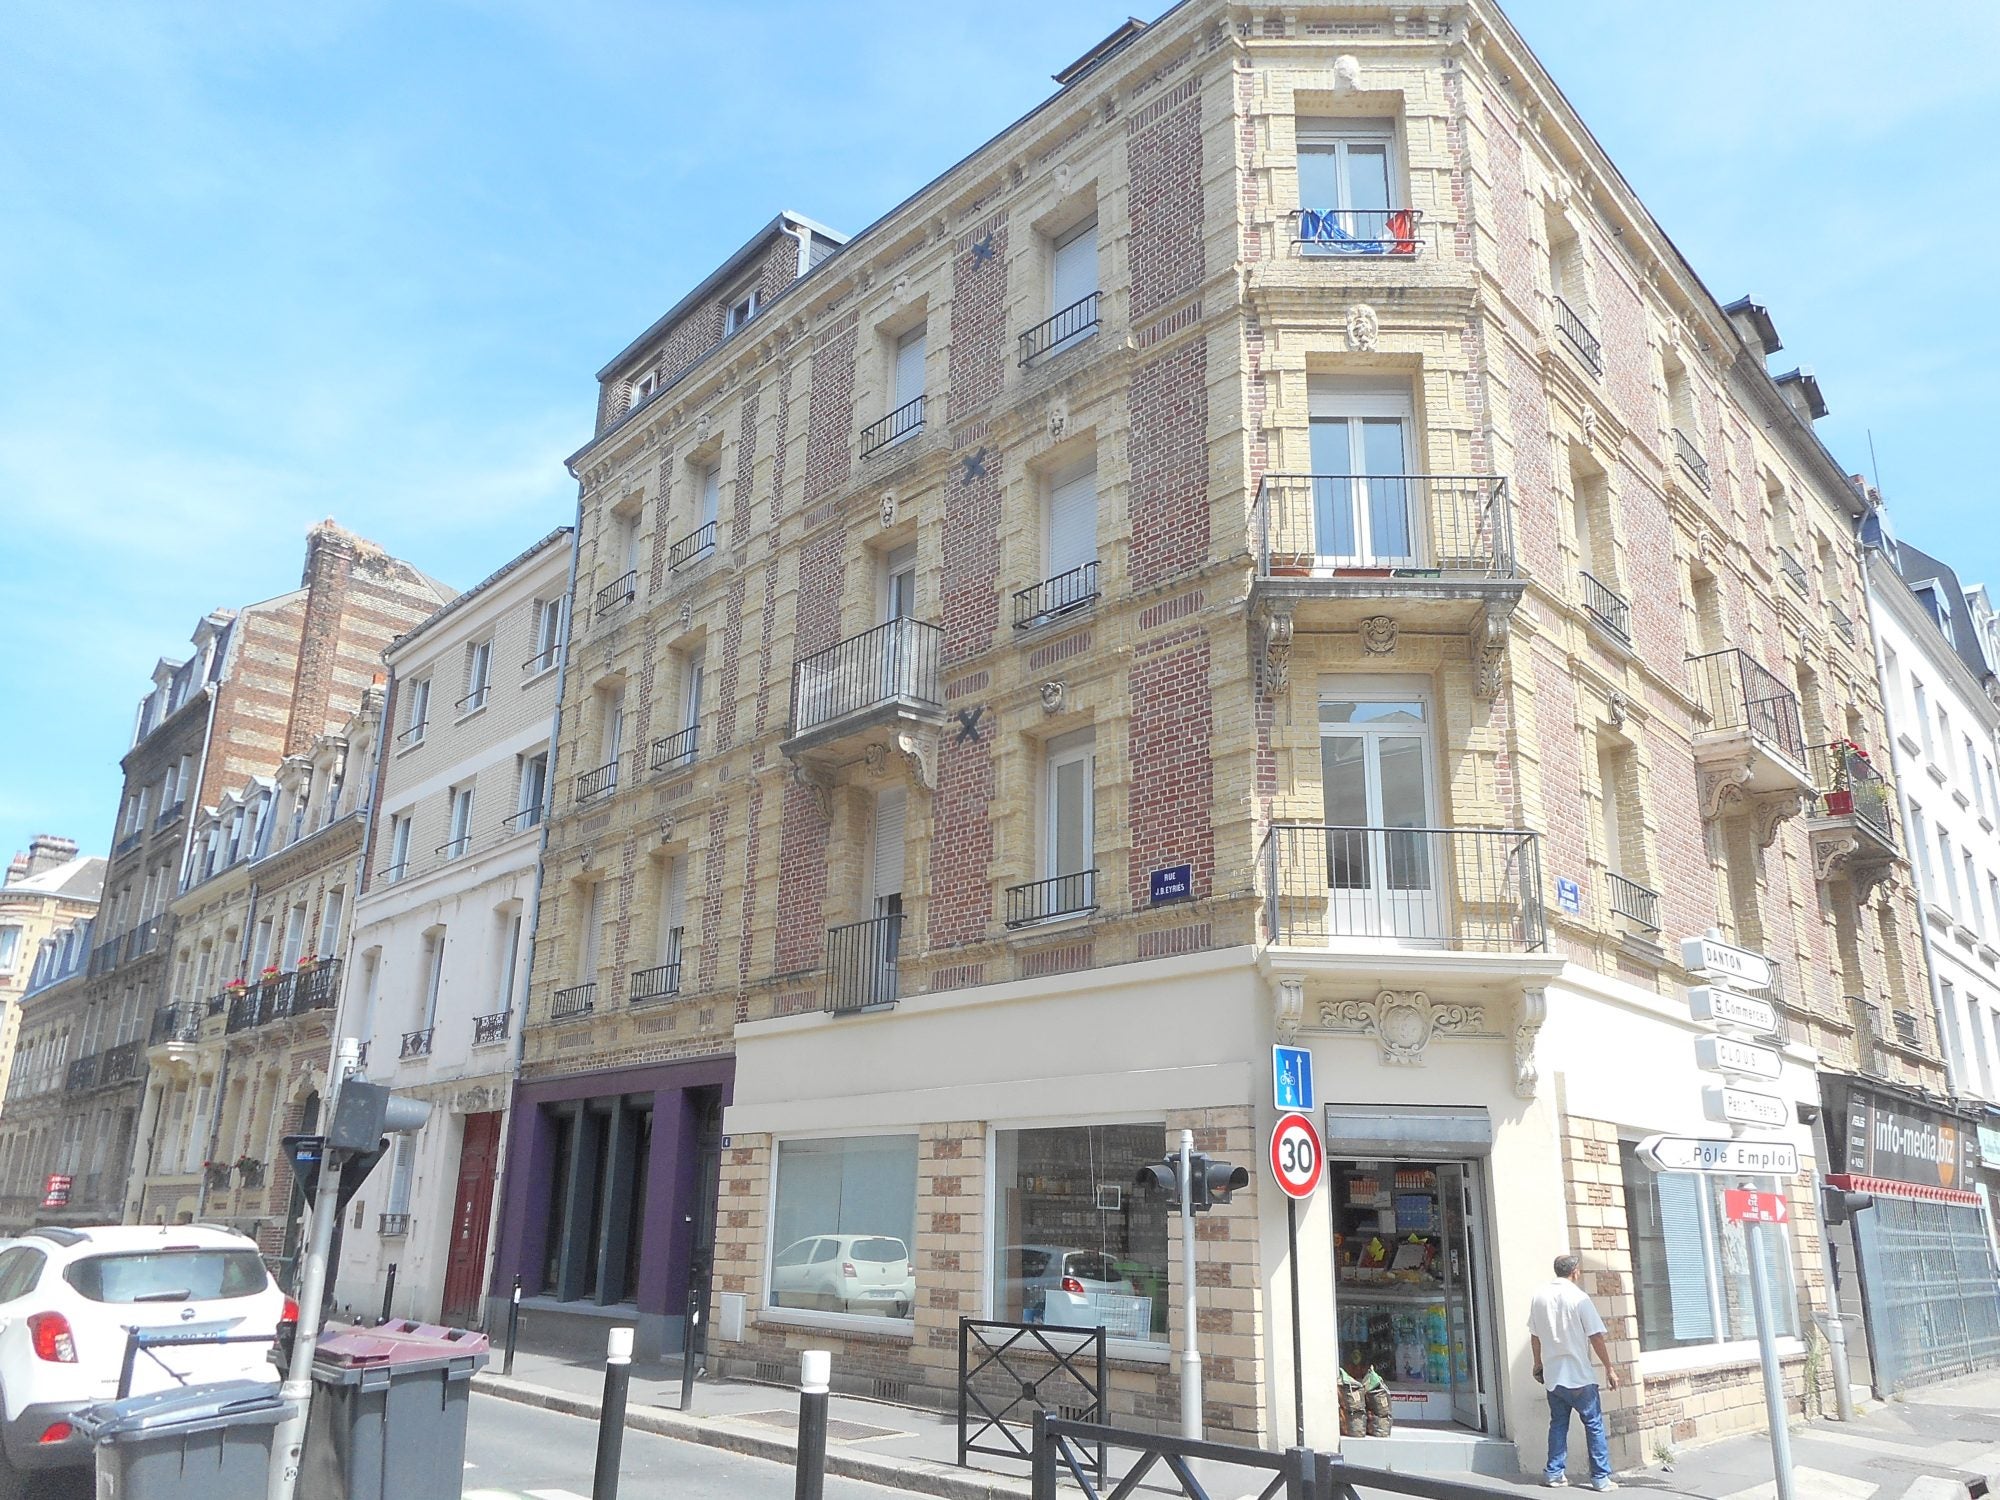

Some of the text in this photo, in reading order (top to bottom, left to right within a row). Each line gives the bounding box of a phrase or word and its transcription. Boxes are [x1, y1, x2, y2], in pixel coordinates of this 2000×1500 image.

[1164, 872, 1176, 881] RUE
[1706, 947, 1742, 971] DANTON
[1725, 999, 1769, 1024] Commerces
[1875, 1111, 1954, 1164] info-media.biz
[1282, 1137, 1313, 1174] 30
[1694, 1147, 1791, 1168] Pôle Emploi
